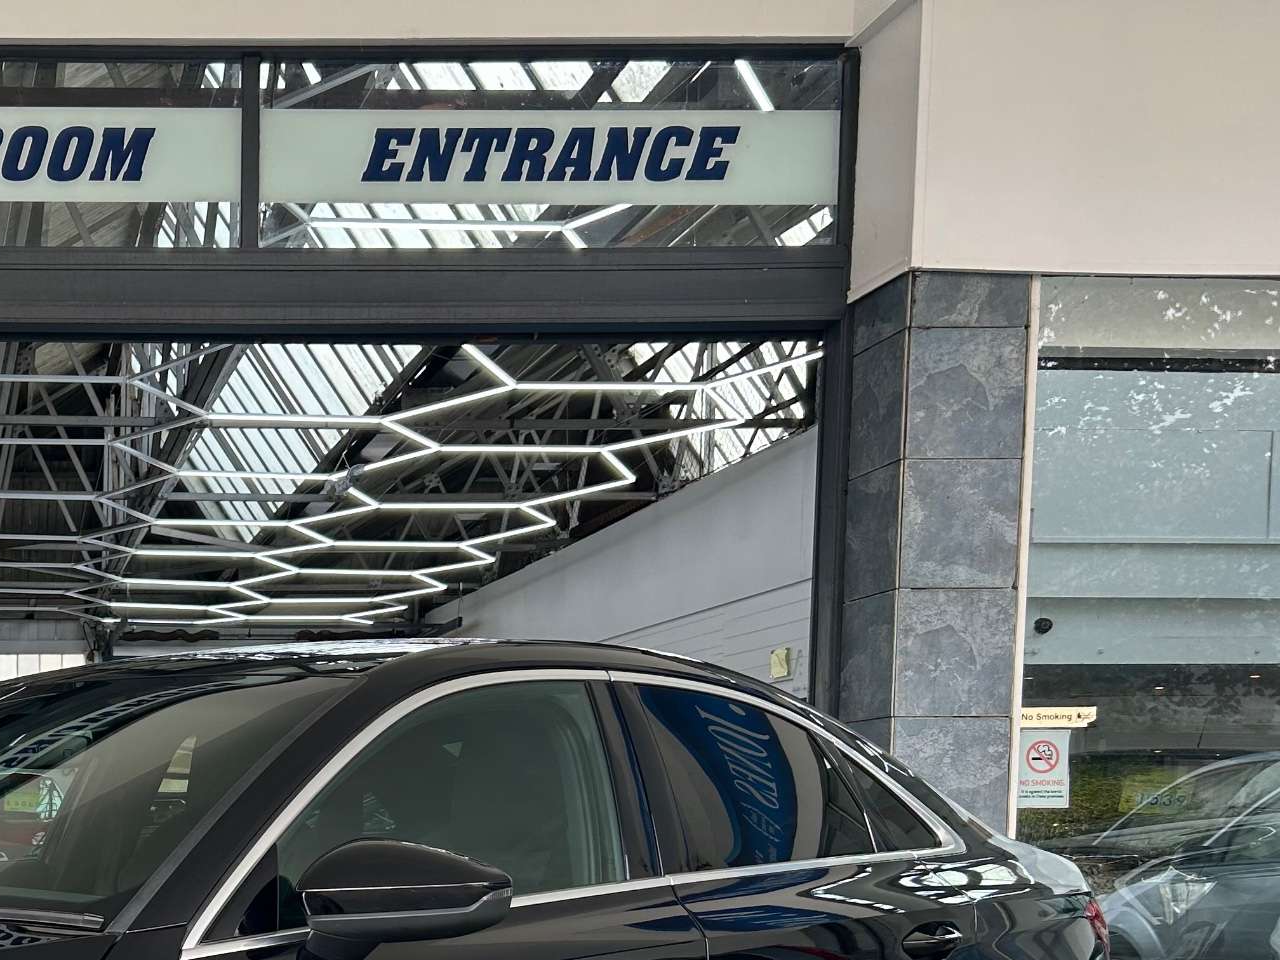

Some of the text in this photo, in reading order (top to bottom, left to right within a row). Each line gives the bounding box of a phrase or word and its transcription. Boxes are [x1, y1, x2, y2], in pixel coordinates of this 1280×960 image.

[360, 125, 742, 184] ENTRANCE
[1021, 712, 1073, 722] No Smoking
